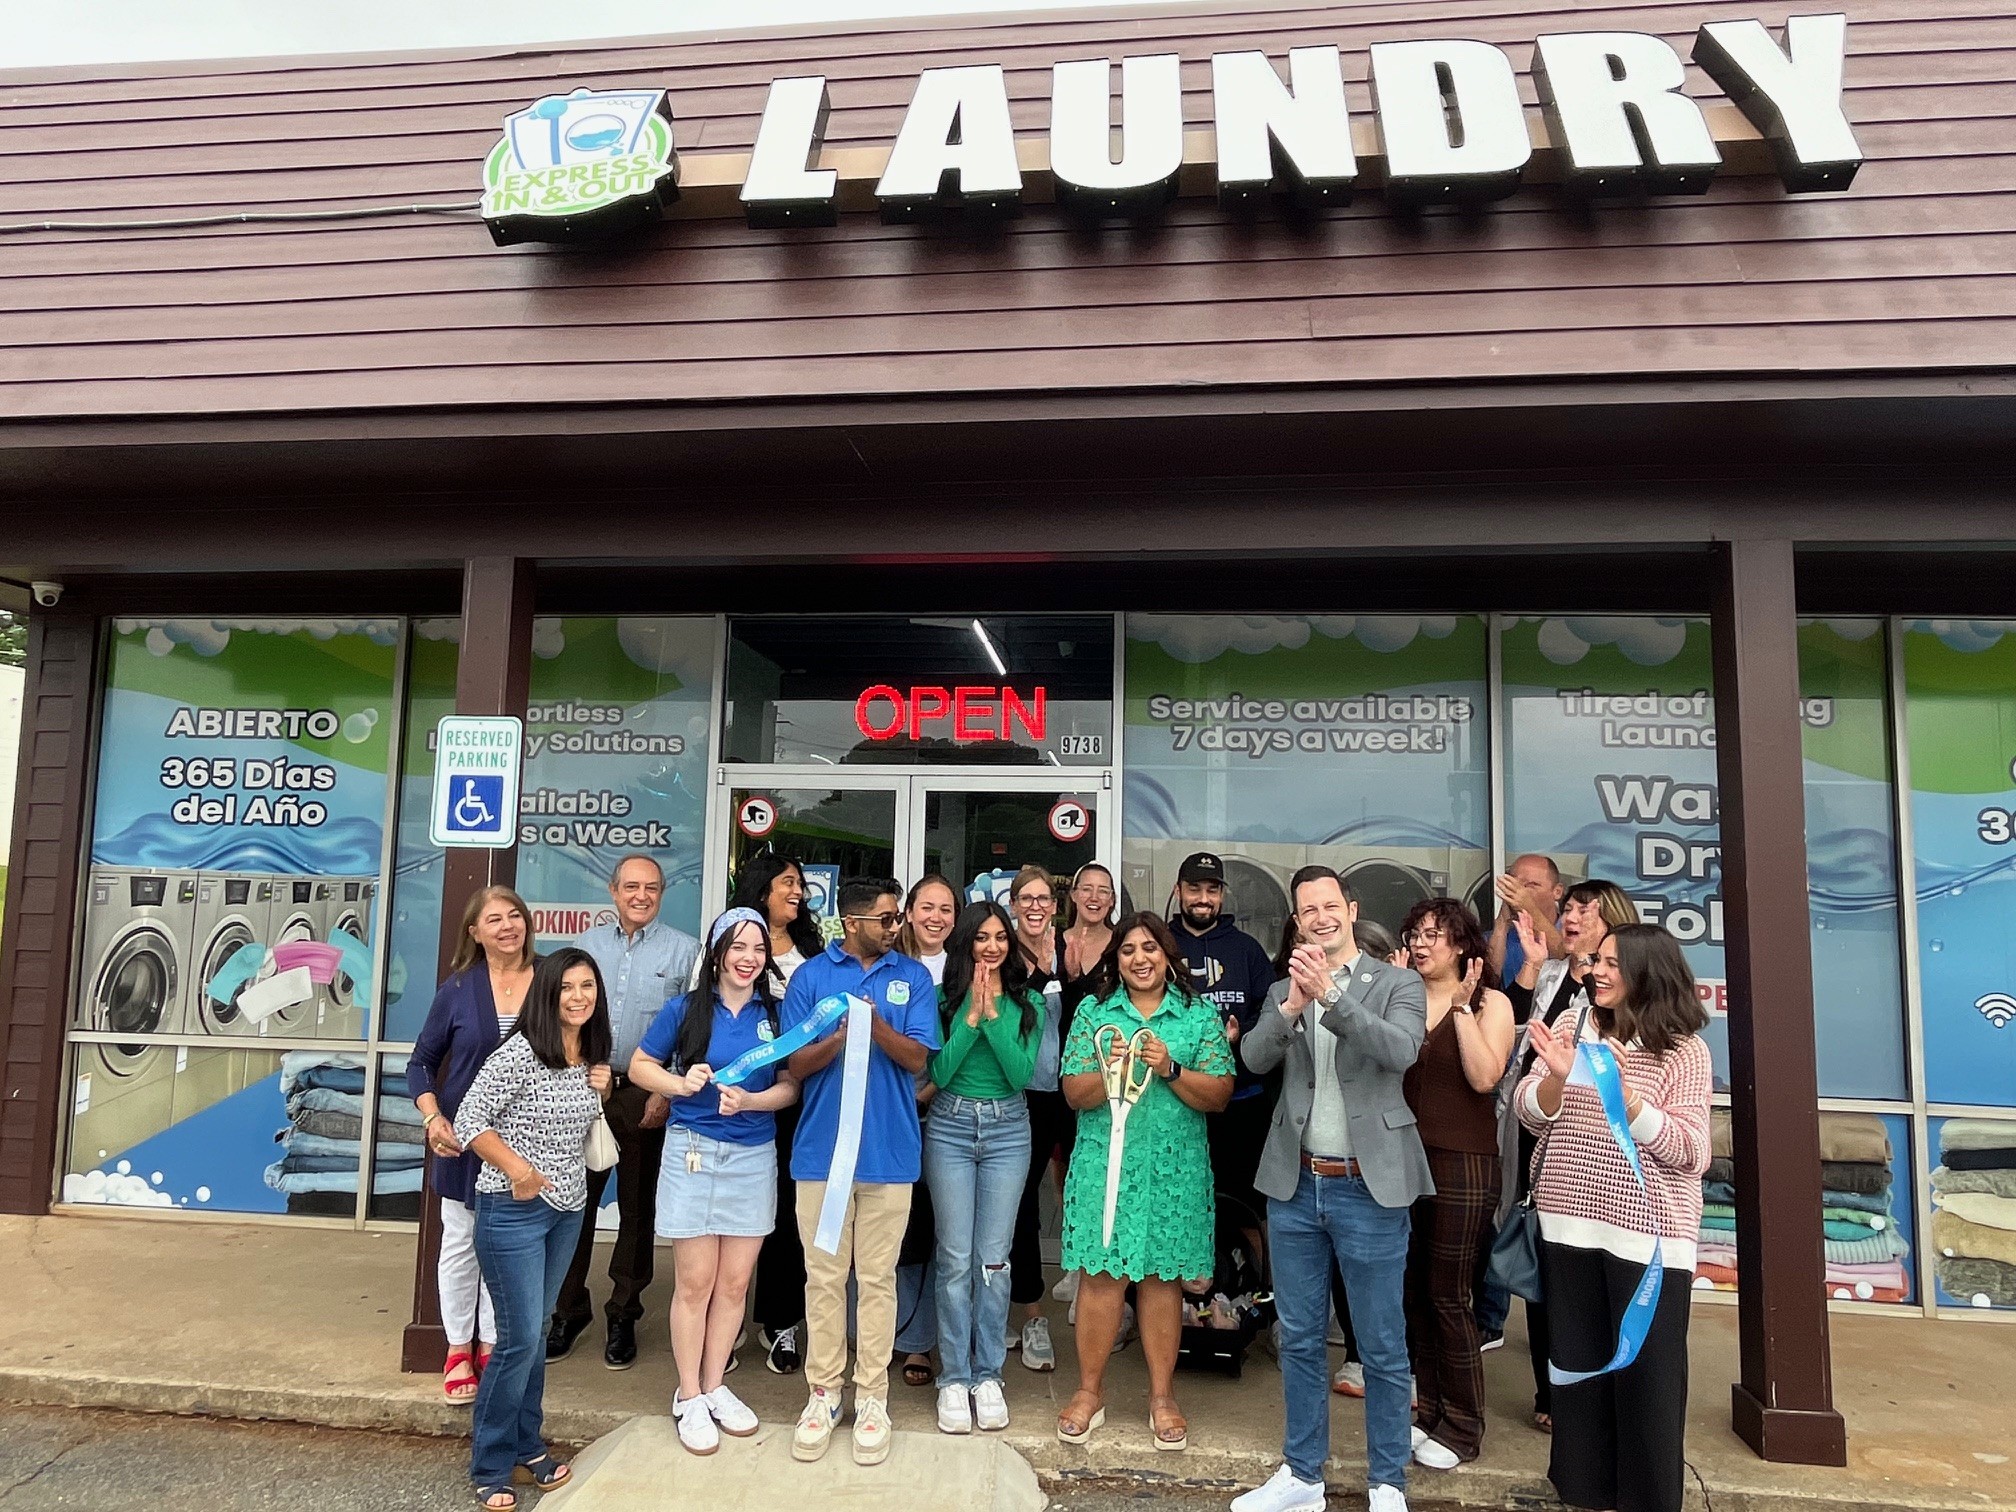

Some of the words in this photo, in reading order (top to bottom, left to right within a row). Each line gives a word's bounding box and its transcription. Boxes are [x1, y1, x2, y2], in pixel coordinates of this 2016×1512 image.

[738, 13, 1864, 206] LAUNDRY
[504, 154, 649, 192] EXPRESS
[493, 190, 530, 212] IN
[540, 185, 569, 205] &
[578, 168, 661, 199] OUT
[526, 701, 622, 724] ortless
[854, 684, 1047, 741] OPEN
[1150, 694, 1286, 720] Service
[1293, 696, 1472, 721] available
[1559, 689, 1659, 715] Tired
[1667, 691, 1707, 716] of
[166, 708, 339, 739] ABIERTO
[446, 730, 513, 747] RESERVED
[549, 730, 684, 753] Solutions
[1062, 736, 1101, 754] 9738
[1173, 725, 1193, 749] 7
[1200, 725, 1292, 757] days
[1299, 730, 1324, 750] a
[1330, 726, 1446, 752] week!
[160, 757, 236, 788] 365
[243, 757, 336, 790] Días
[448, 751, 508, 768] PARKING
[171, 794, 238, 825] del
[242, 796, 327, 827] Año
[520, 789, 631, 815] ailable
[545, 826, 567, 844] a
[573, 822, 670, 847] Week
[1641, 837, 1722, 878] Dr
[532, 909, 592, 934] OKING
[1632, 900, 1725, 942] Fol
